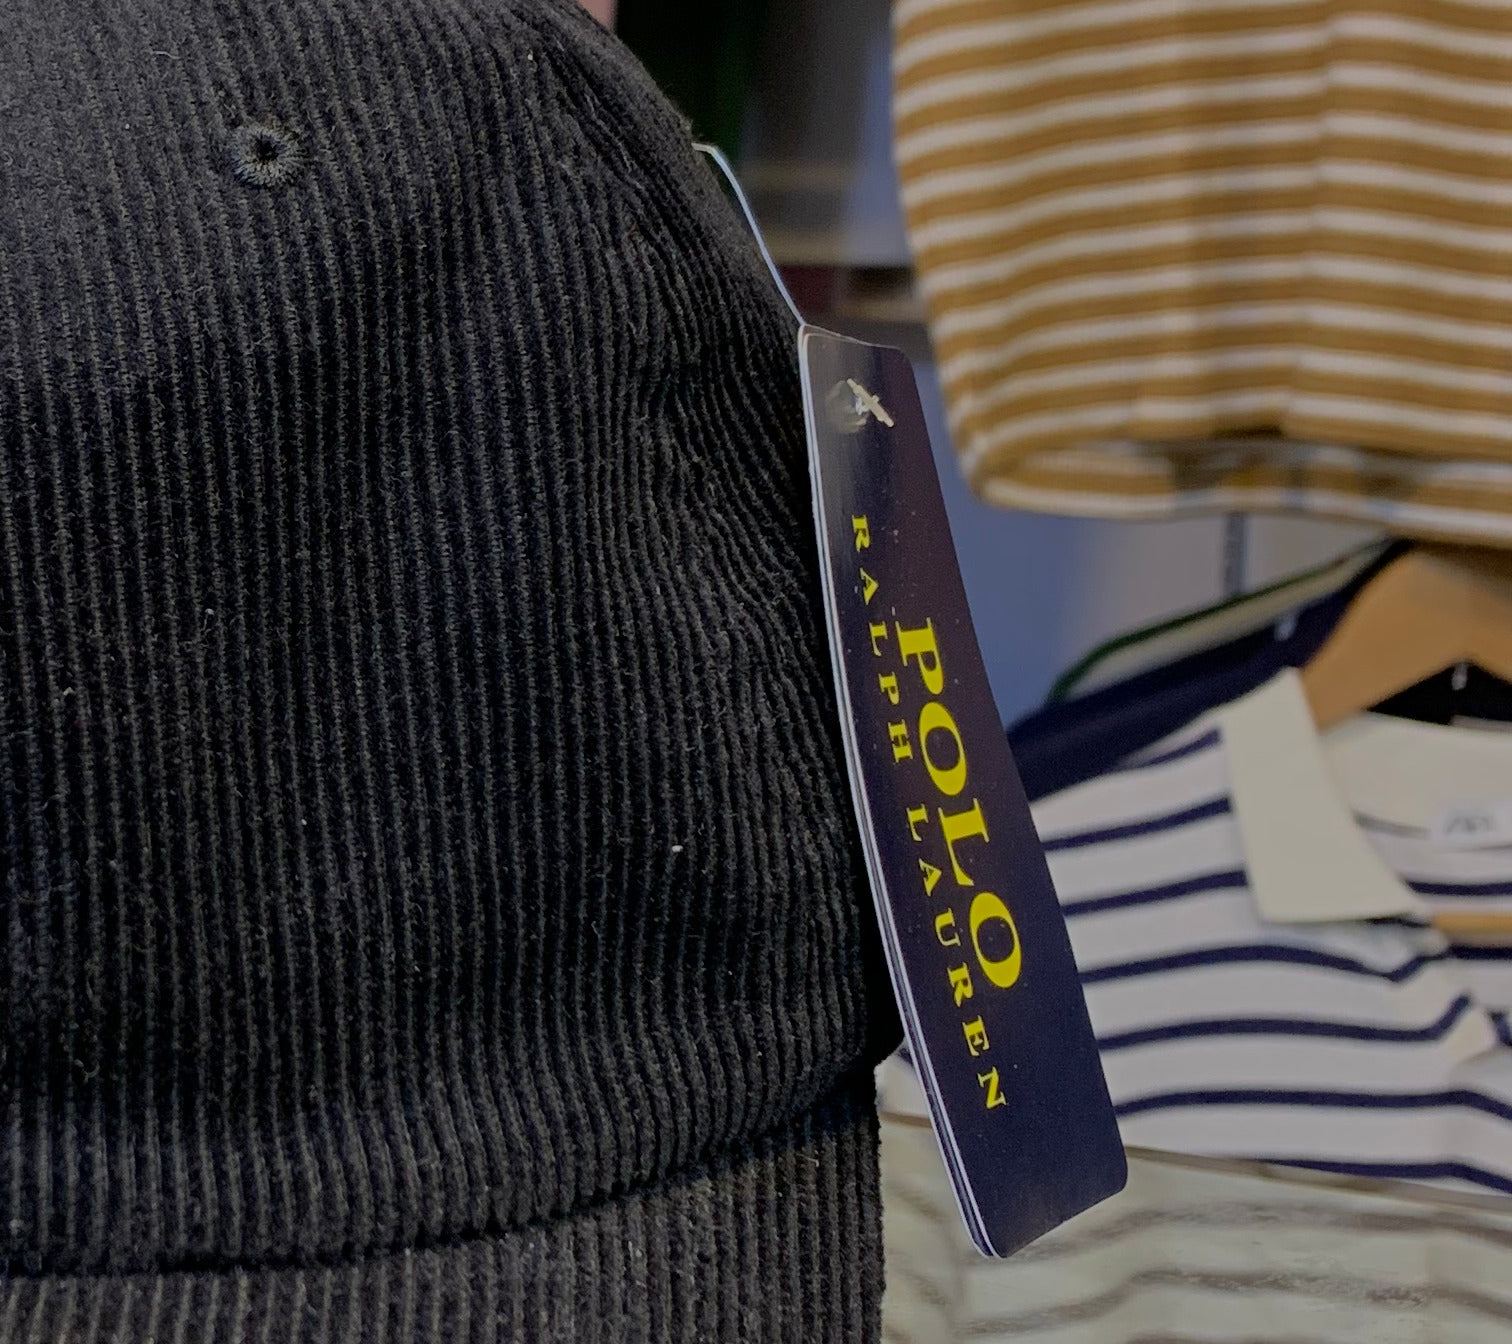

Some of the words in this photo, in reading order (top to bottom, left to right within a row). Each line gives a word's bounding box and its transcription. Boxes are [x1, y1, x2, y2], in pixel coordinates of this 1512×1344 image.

[851, 513, 914, 764] RALPH
[905, 803, 1008, 1112] LAUREN
[895, 616, 1024, 989] POLO
